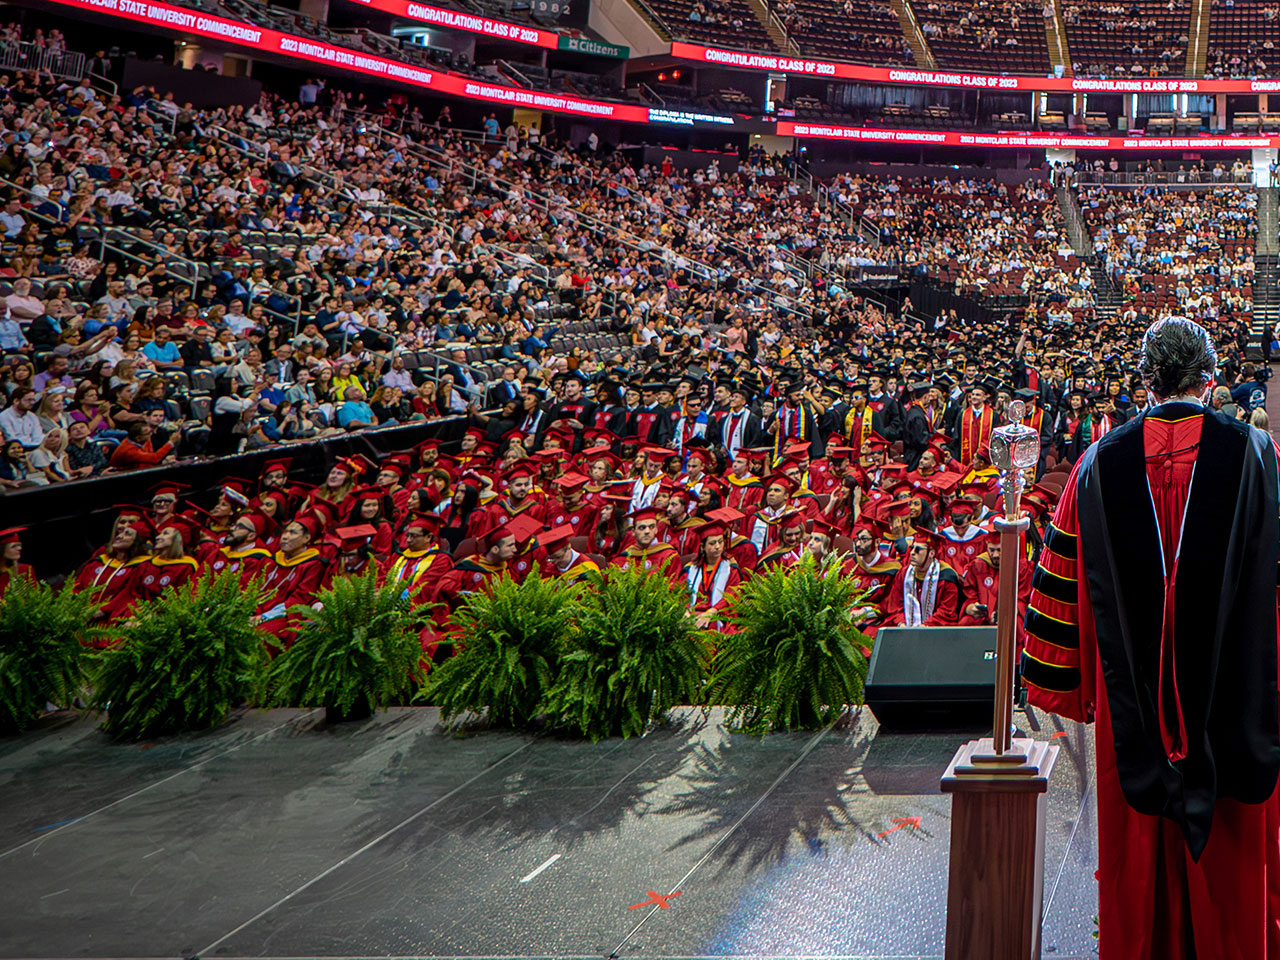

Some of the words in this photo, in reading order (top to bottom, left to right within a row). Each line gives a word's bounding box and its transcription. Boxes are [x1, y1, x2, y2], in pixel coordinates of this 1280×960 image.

[531, 0, 571, 16] 1982
[119, 0, 146, 15] STATE
[148, 6, 196, 27] UNIVERSITY
[197, 18, 261, 42] COMMENCEMENT
[408, 4, 482, 30] CONGRATULATIONS
[484, 21, 508, 36] CLASS
[510, 27, 519, 38] OF
[520, 29, 538, 42] 2023
[580, 40, 618, 56] Citizens
[281, 38, 297, 51] 2023
[299, 42, 335, 60] MONTCLAIR
[336, 52, 353, 65] STATE
[355, 56, 387, 72] UNIVERSITY
[388, 64, 431, 83] COMMENCEMENT
[706, 49, 777, 68] CONGRATULATIONS
[779, 59, 803, 71] CLASS
[805, 62, 815, 72] OF
[817, 64, 835, 74] 2023
[890, 71, 961, 84] CONGRATULATIONS
[963, 76, 986, 86] CLASS
[988, 78, 997, 86] OF
[999, 78, 1017, 87] 2023
[1073, 80, 1141, 90] CONGRATULATIONS
[1143, 82, 1167, 90] CLASS
[1168, 82, 1178, 90] OF
[466, 84, 480, 94] 2023
[481, 87, 515, 100] MONTCLAIR
[516, 93, 533, 103] STATE
[534, 96, 566, 108] UNIVERSITY
[567, 101, 613, 114] COMMENCEMENT
[794, 126, 808, 134] 2023
[810, 127, 842, 136] MONTCLAIR
[844, 129, 860, 138] STATE
[861, 131, 895, 139] UNIVERSITY
[896, 133, 945, 141] COMMENCEMENT
